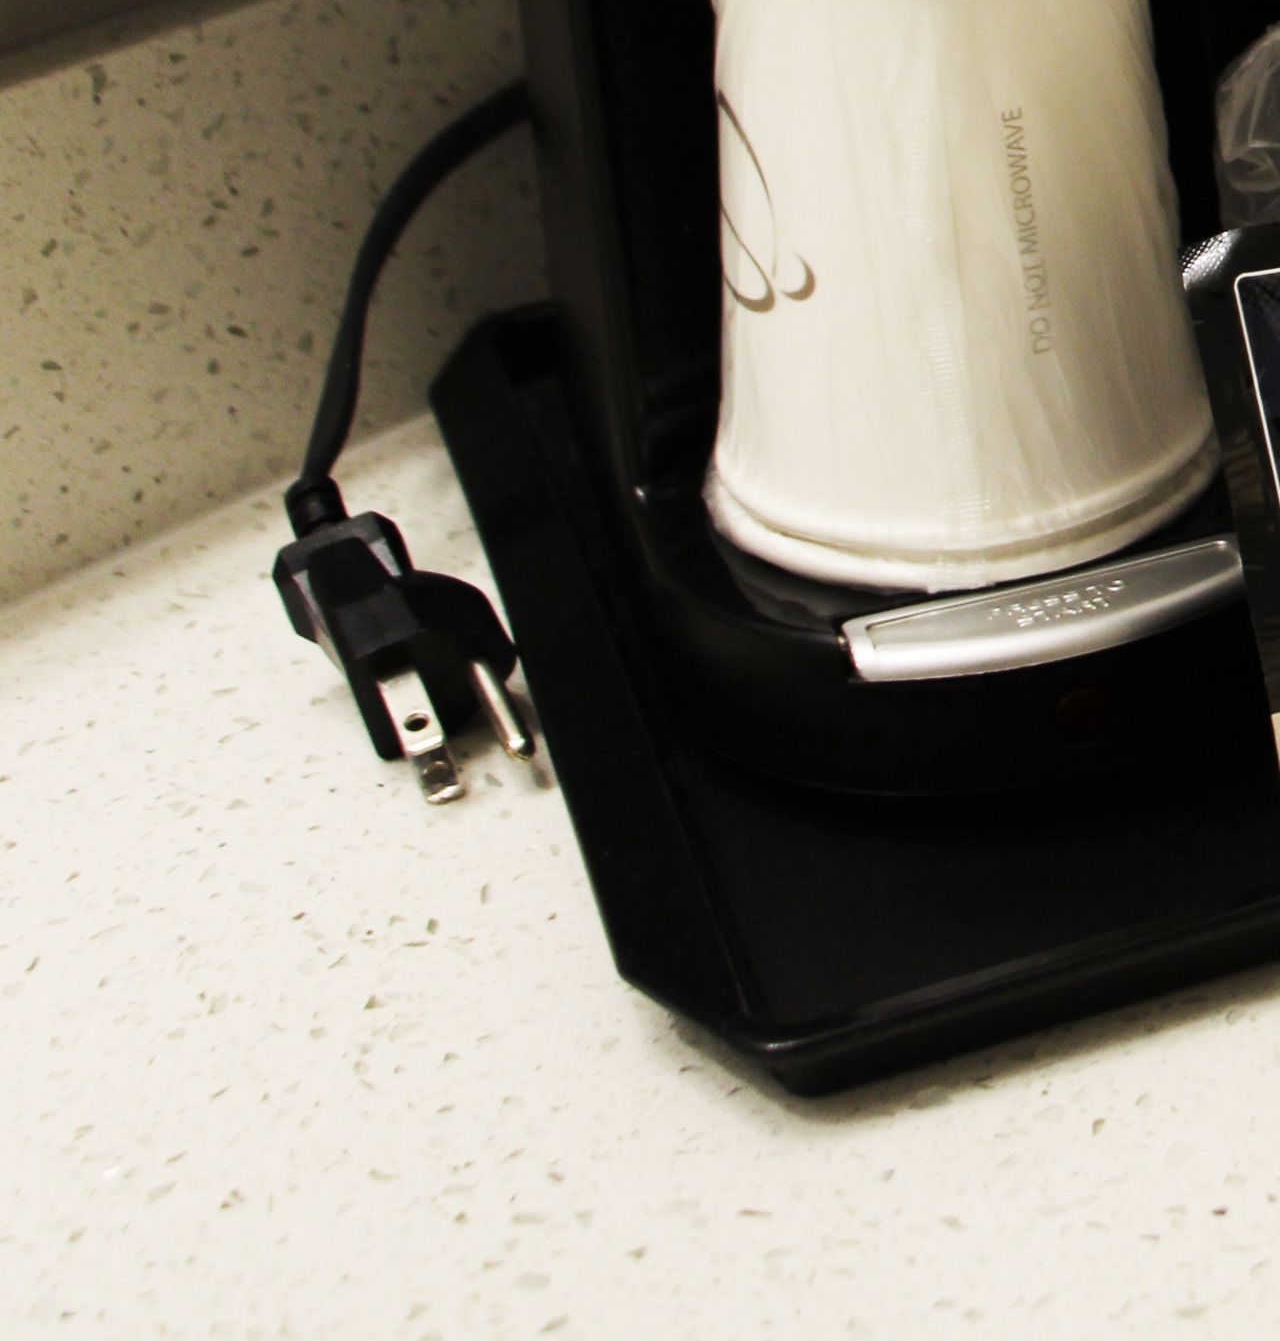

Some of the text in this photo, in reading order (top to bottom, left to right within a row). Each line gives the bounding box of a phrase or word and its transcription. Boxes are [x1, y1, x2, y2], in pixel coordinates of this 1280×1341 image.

[1002, 108, 1051, 355] DO NOT MICROWAVE
